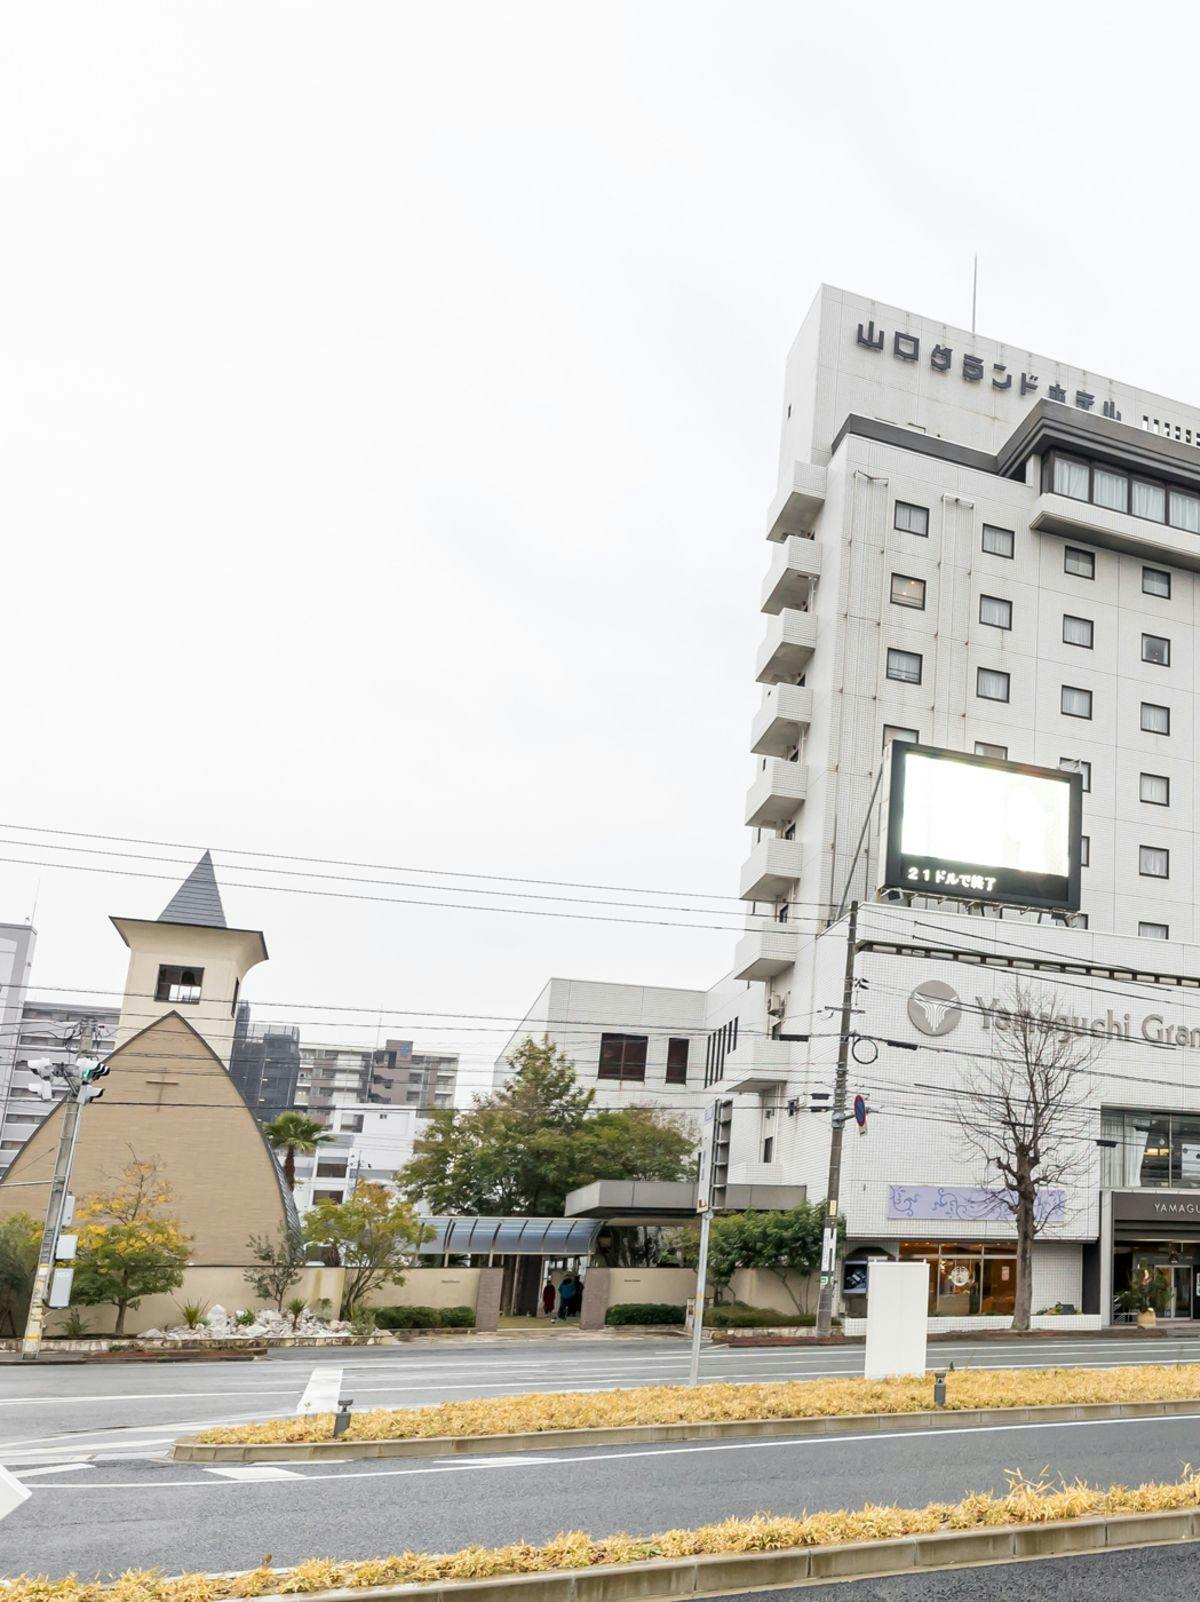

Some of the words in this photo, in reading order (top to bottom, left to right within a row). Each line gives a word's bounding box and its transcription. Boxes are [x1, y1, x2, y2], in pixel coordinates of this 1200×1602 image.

[857, 321, 1122, 421] 山口グランドホテル
[975, 996, 1131, 1044] Yamaguchi
